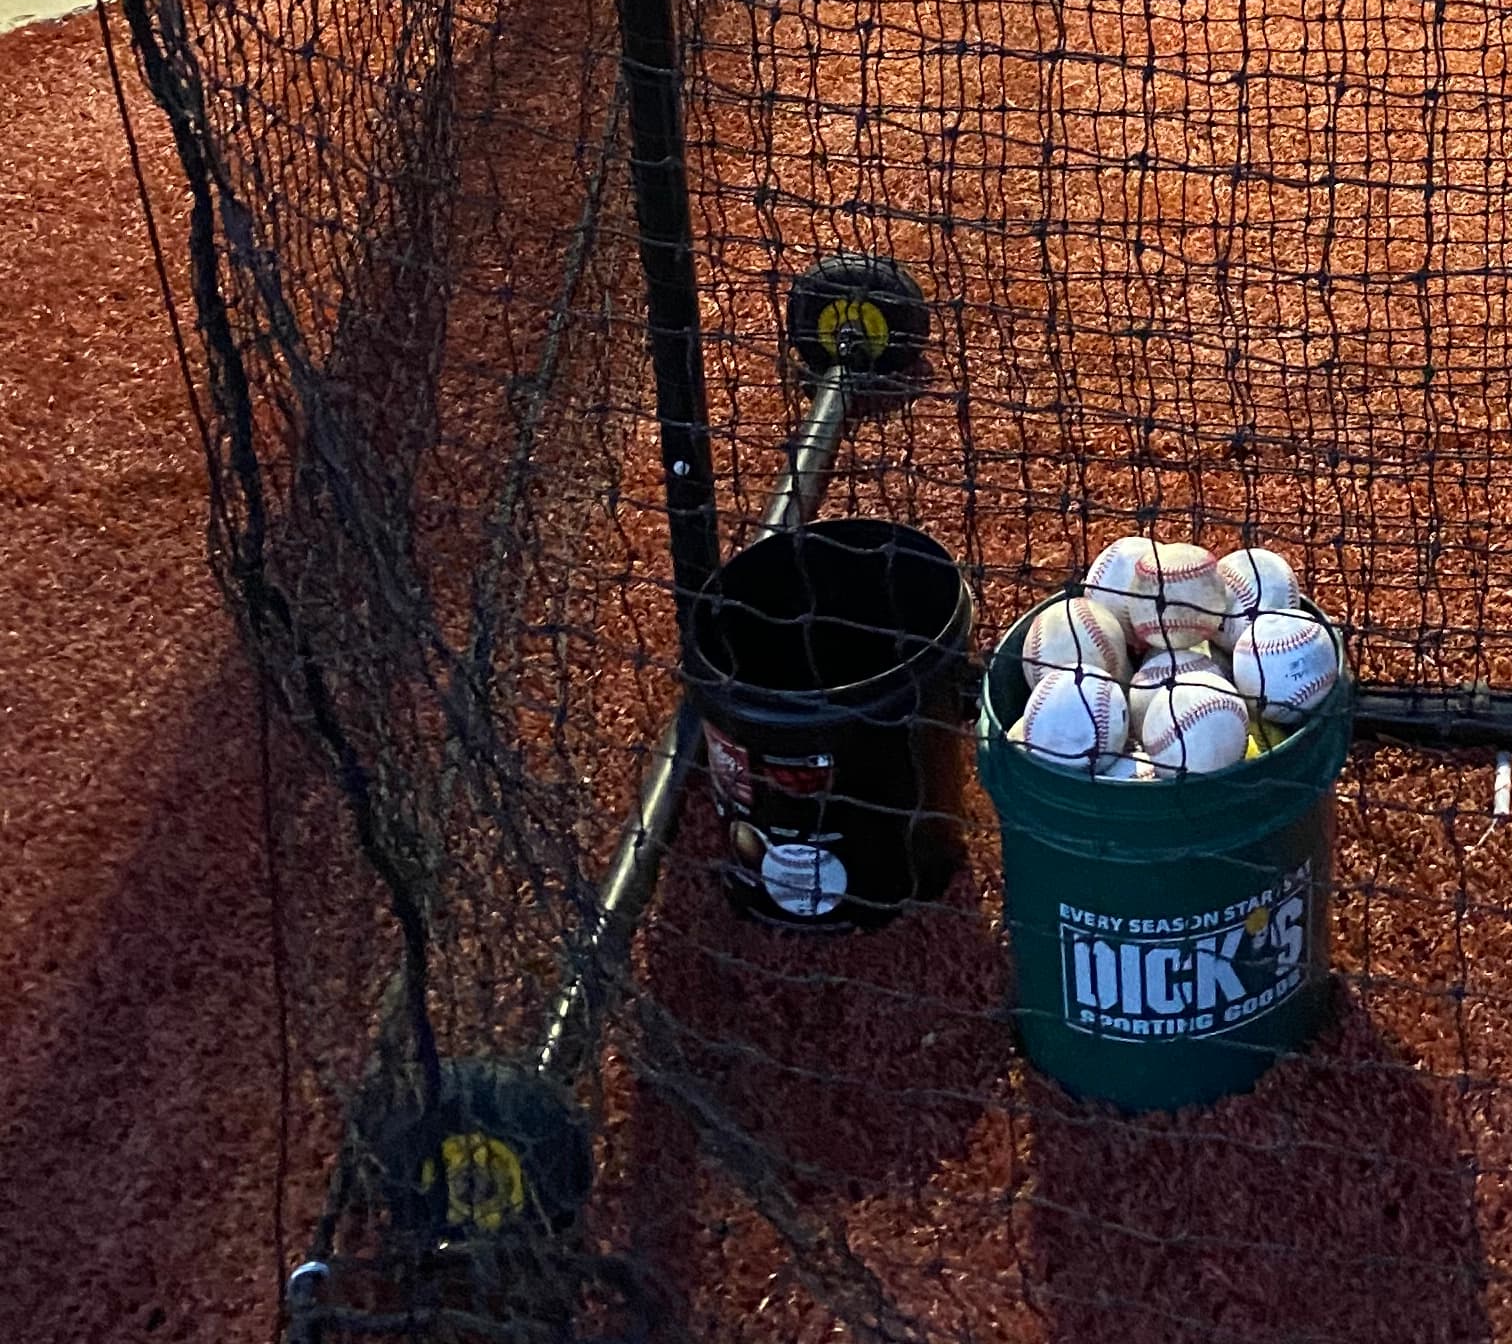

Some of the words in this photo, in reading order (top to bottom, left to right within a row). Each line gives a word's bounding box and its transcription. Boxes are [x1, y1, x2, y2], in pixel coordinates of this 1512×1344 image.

[1060, 903, 1123, 931] EVERY
[1128, 912, 1219, 934] SEASON
[1224, 878, 1292, 922] STARS
[1074, 899, 1303, 1014] DICK'S
[1080, 1009, 1213, 1035] SPORTING
[1224, 967, 1300, 1022] GOODS
